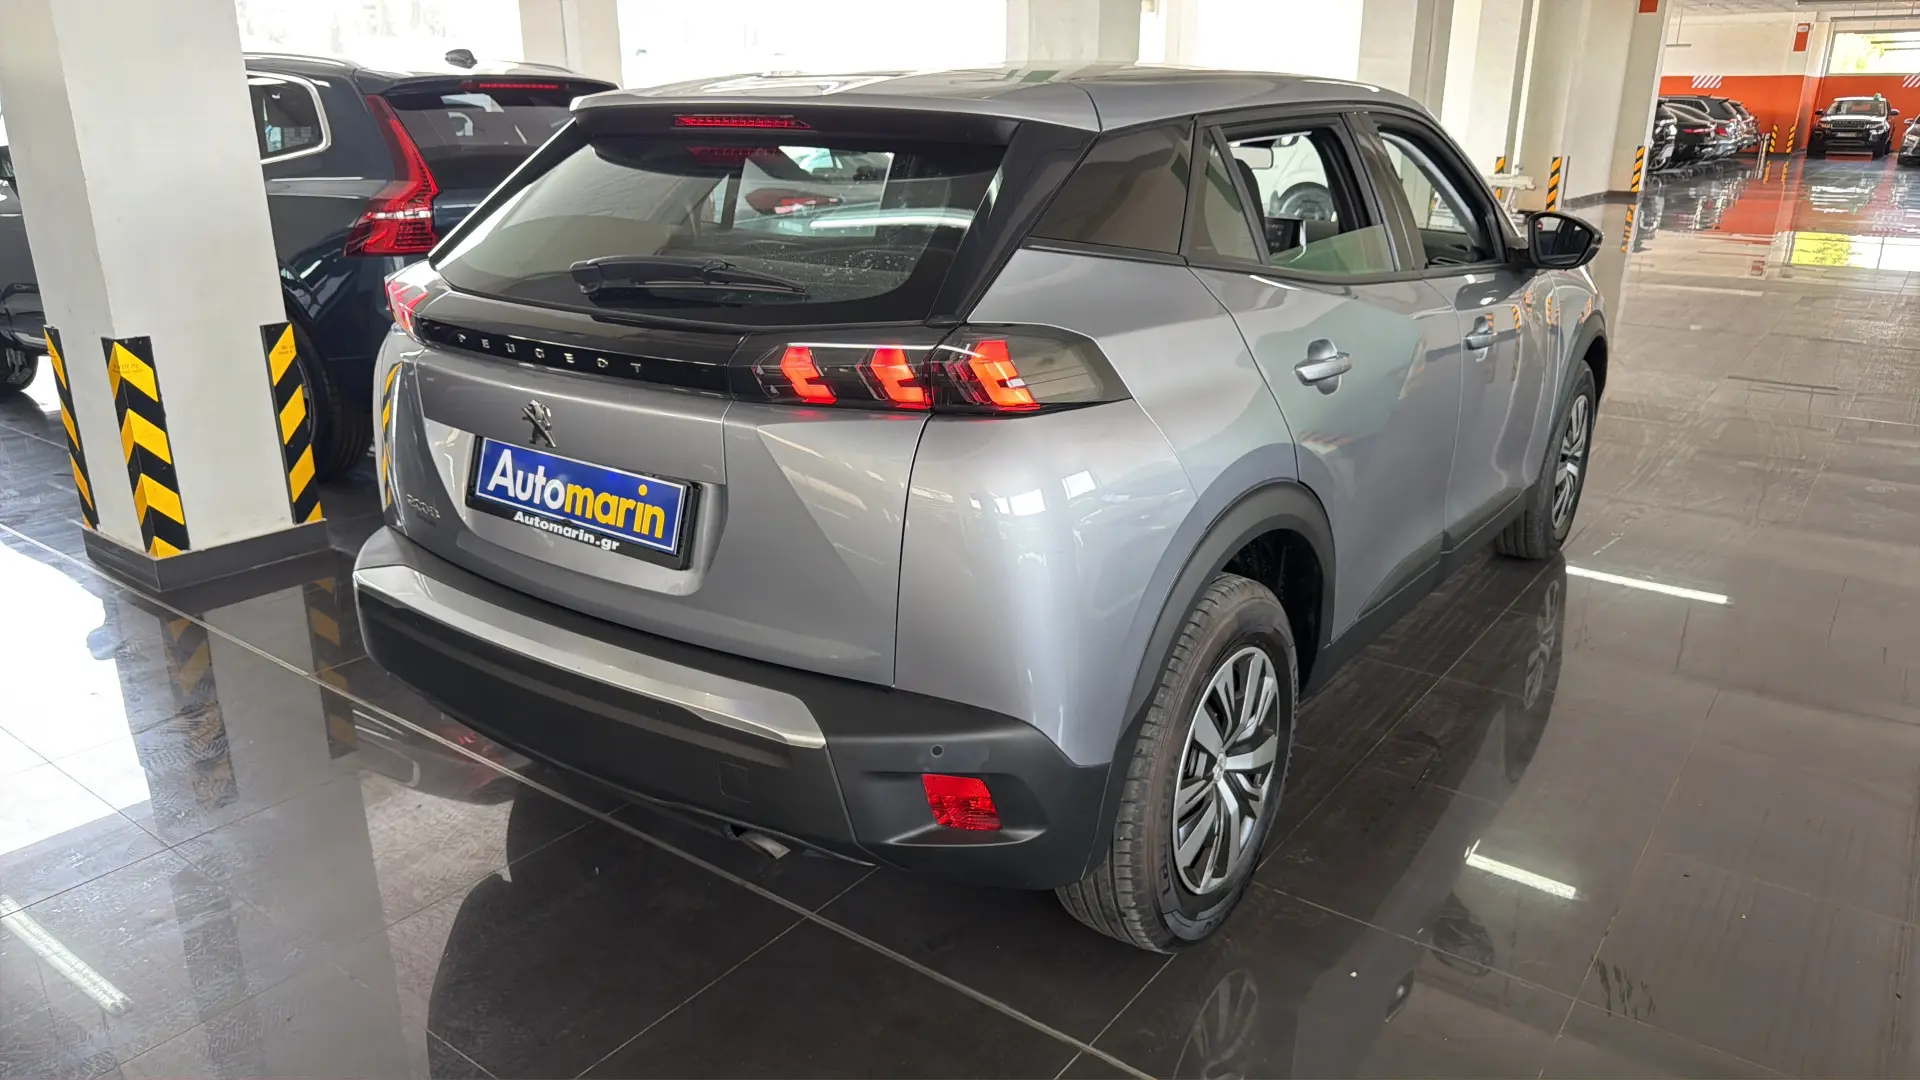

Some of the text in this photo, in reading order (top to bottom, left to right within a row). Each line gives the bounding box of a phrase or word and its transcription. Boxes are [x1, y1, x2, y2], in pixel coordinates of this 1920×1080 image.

[457, 333, 642, 374] PEUGEOT
[487, 449, 665, 538] Automarin
[513, 511, 620, 551] Automarin.gr
